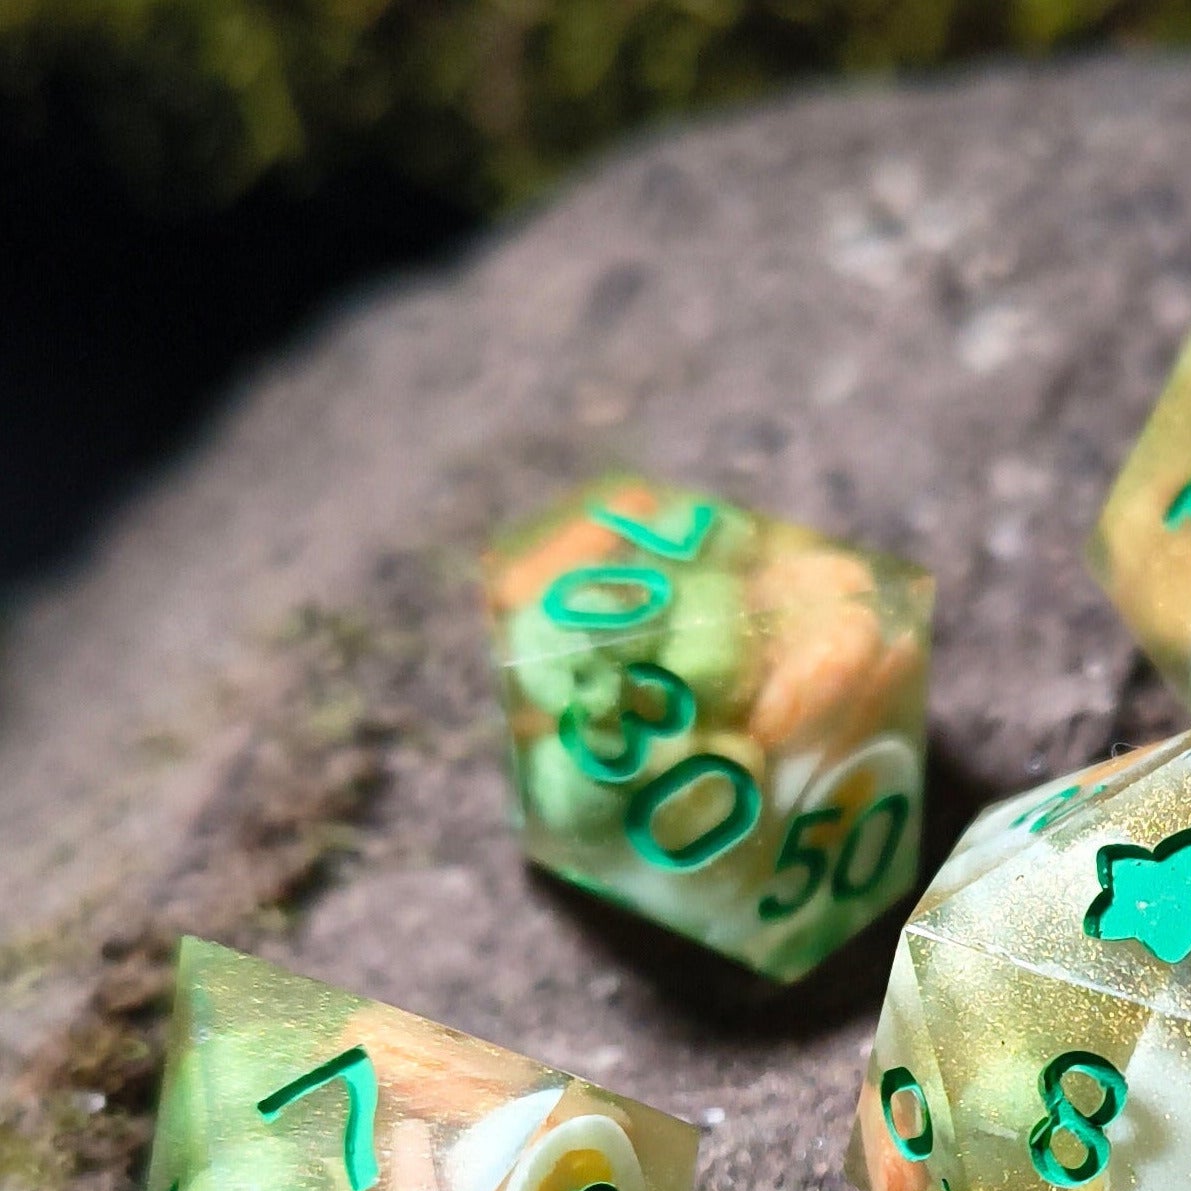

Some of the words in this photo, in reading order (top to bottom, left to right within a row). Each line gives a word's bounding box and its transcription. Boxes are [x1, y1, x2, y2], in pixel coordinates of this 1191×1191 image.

[542, 496, 718, 630] 70
[558, 661, 763, 873] 30
[757, 793, 910, 921] 50
[1027, 1050, 1129, 1190] 8
